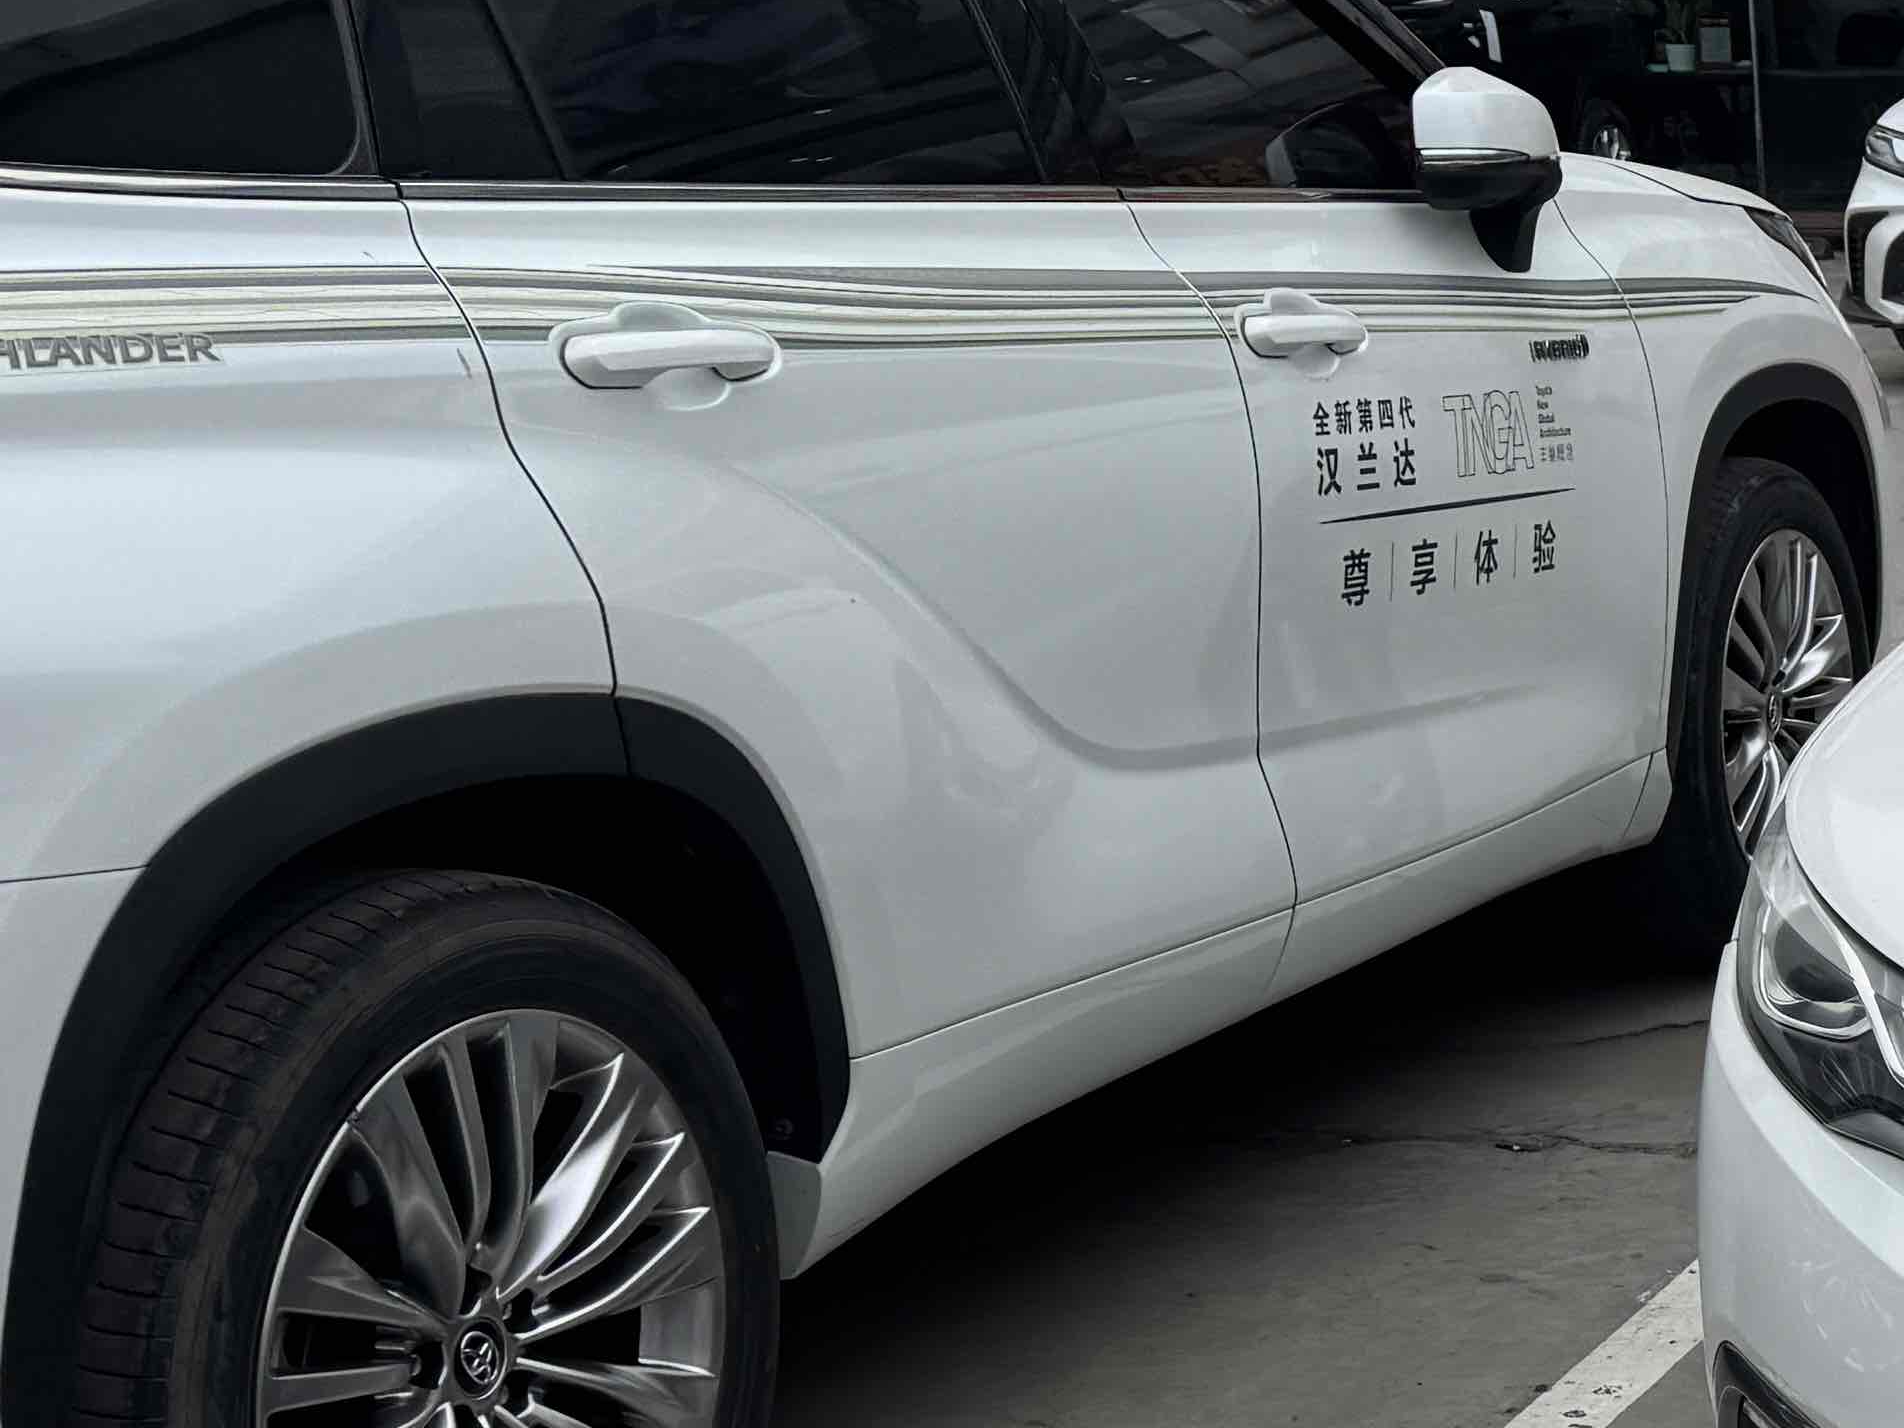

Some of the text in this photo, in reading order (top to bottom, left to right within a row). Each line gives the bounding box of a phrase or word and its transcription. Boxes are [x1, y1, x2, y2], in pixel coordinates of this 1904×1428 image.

[1312, 395, 1416, 436] 全新第四代
[1316, 437, 1417, 496] 汉兰达
